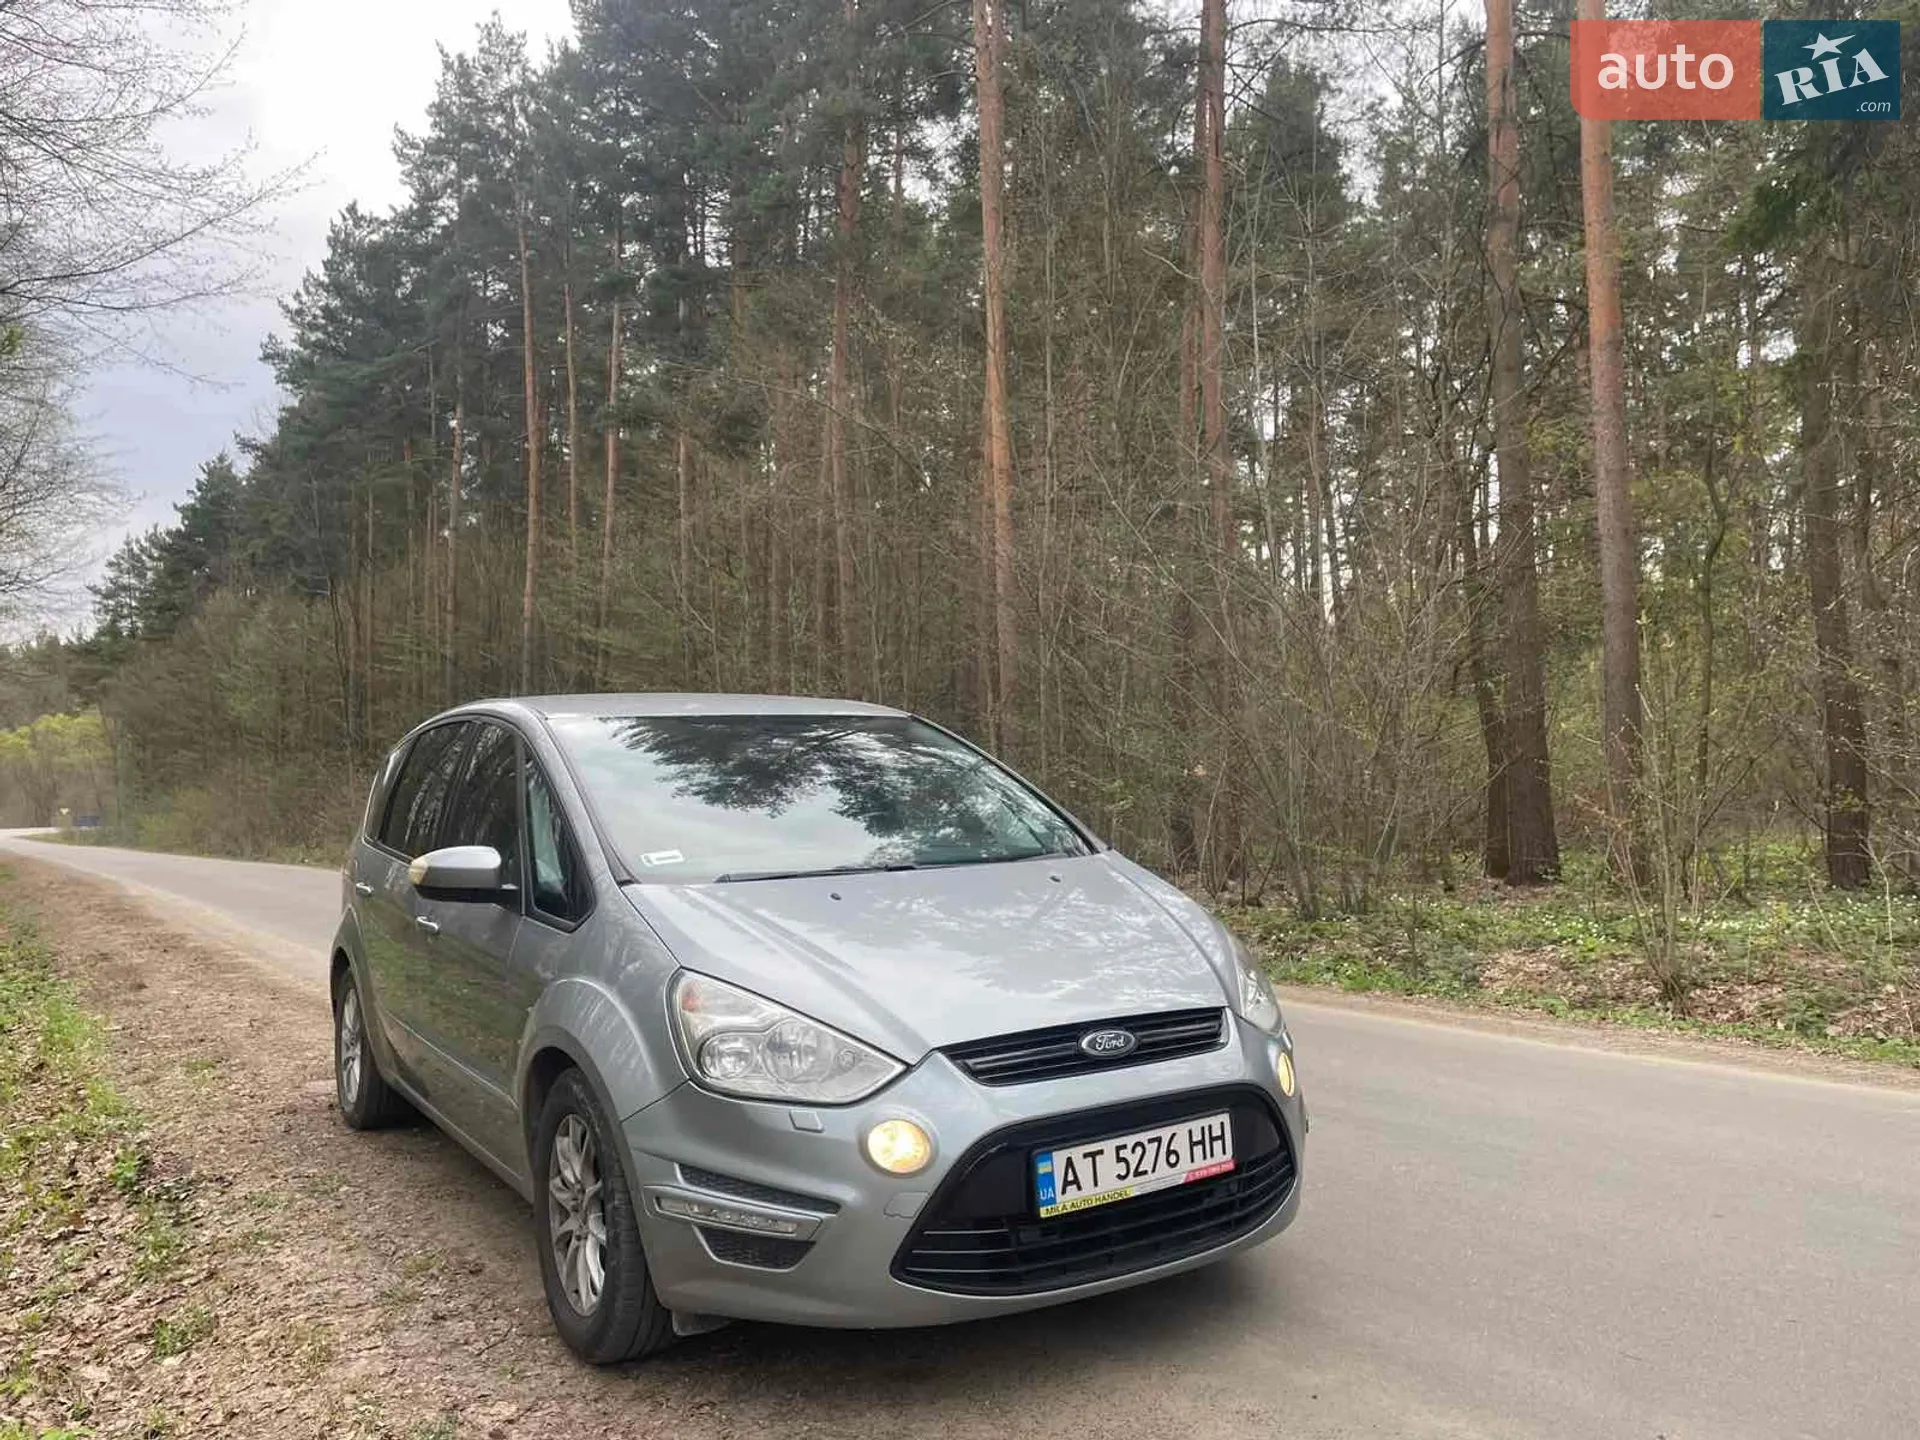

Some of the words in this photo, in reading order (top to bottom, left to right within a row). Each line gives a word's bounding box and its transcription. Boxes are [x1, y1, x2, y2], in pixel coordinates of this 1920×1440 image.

[1093, 1033, 1125, 1051] Ford
[1061, 1149, 1104, 1195] AT
[1115, 1132, 1180, 1181] 5276
[1188, 1121, 1227, 1163] HH
[1040, 1187, 1055, 1201] UA
[1070, 1198, 1093, 1210] AUTO
[1094, 1190, 1130, 1204] HANDEL
